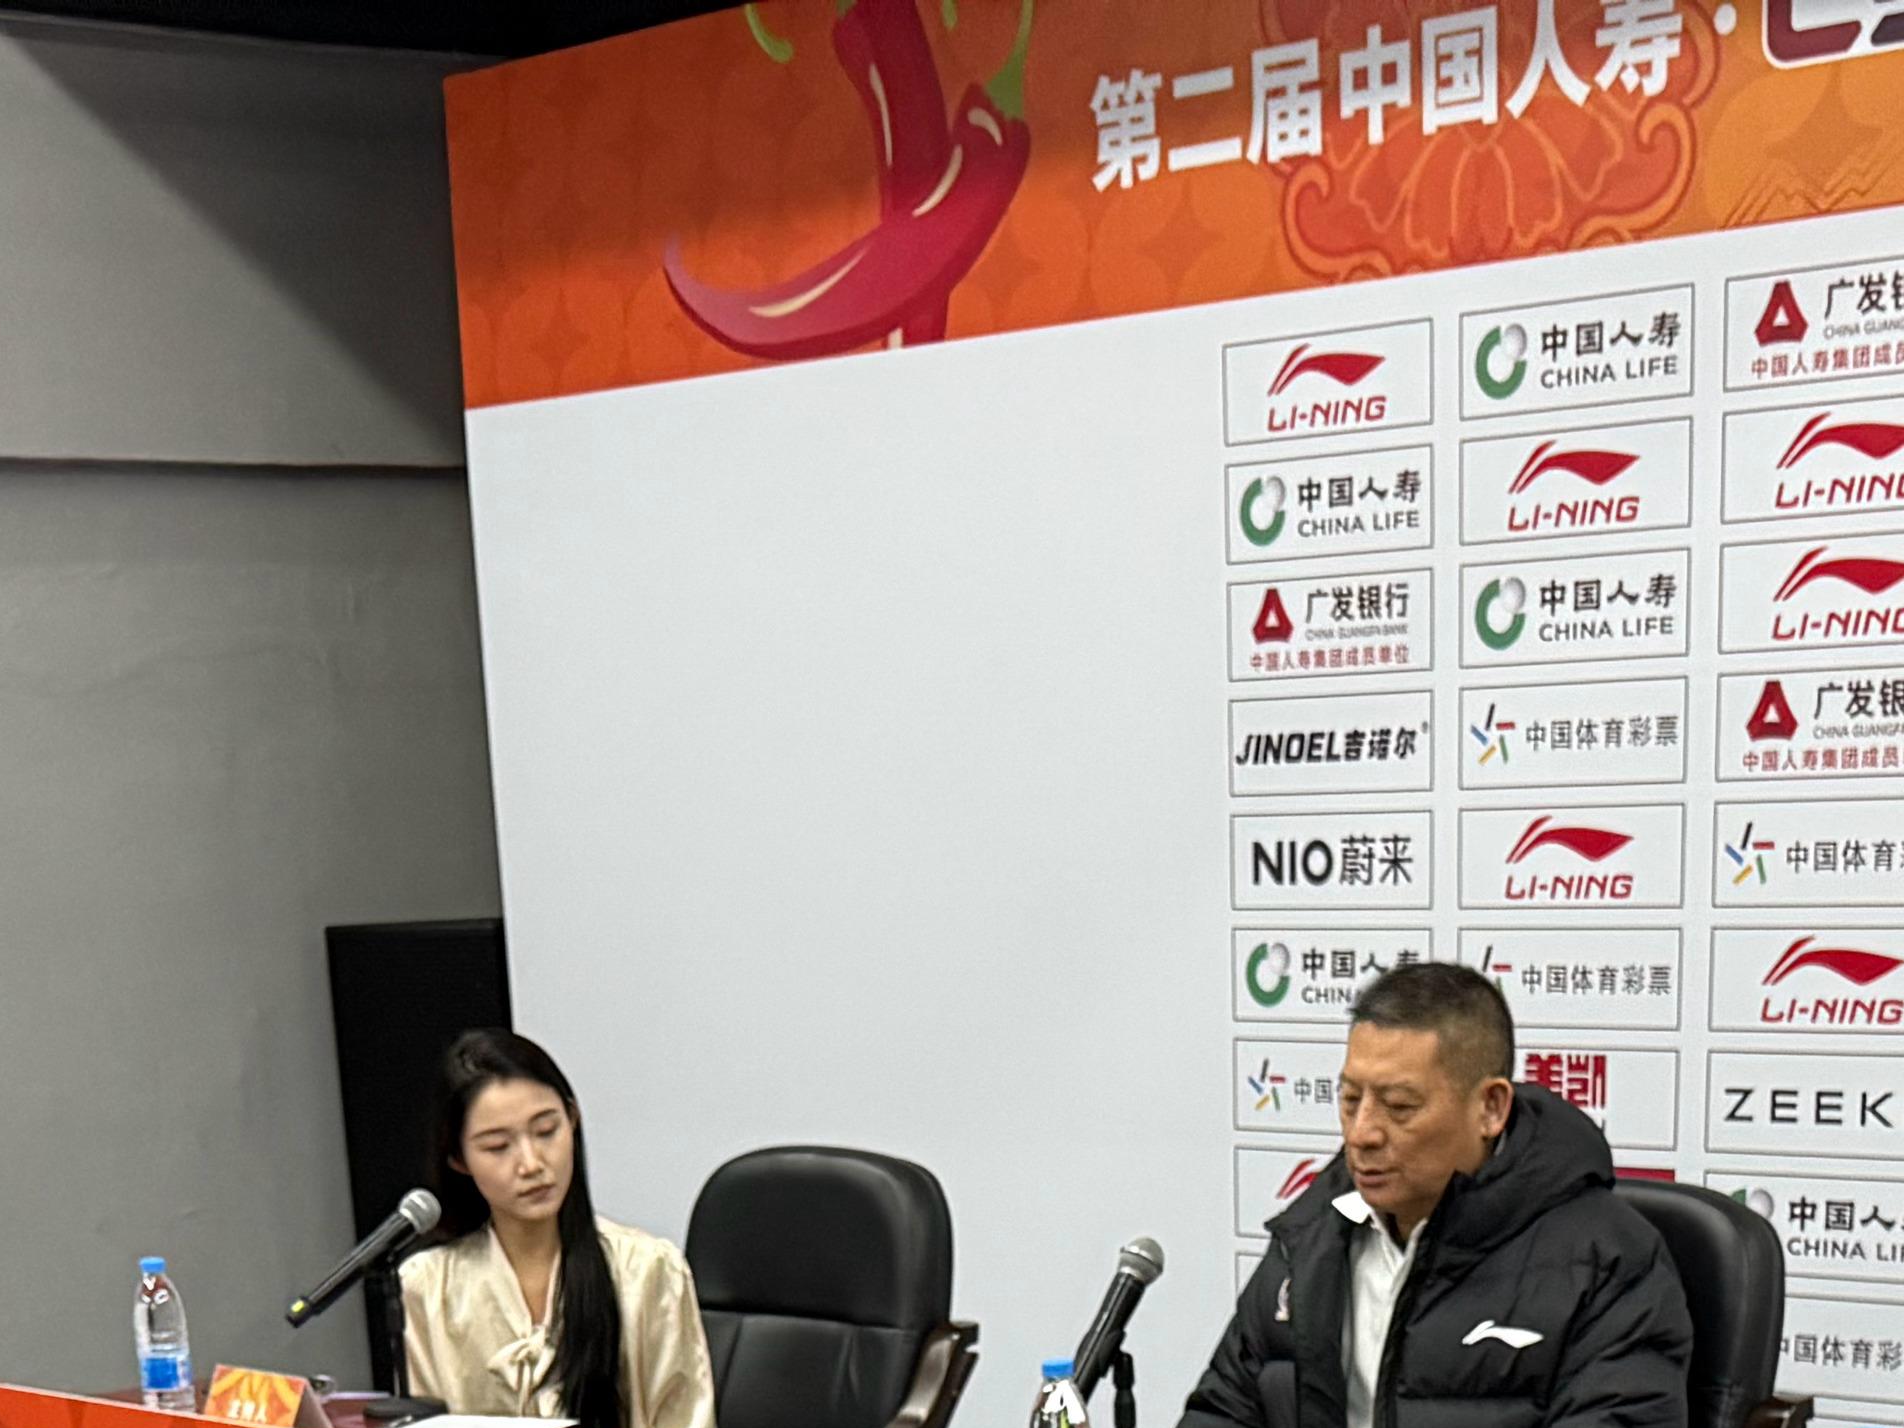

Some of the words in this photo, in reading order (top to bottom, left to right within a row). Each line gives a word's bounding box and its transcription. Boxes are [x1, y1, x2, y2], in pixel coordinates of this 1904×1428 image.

[1542, 312, 1680, 362] 中国人寿
[1541, 364, 1616, 389] CHINA
[1626, 355, 1677, 379] LIFE
[1268, 396, 1386, 432] LI-NING
[1298, 470, 1420, 512] 中国人寿
[1298, 516, 1364, 537] CHINA
[1373, 510, 1419, 531] LIFE
[1508, 496, 1639, 531] LI-NING
[1306, 583, 1408, 622] 广发银行
[1540, 574, 1676, 616] 中国人寿
[1539, 621, 1613, 641] CHINA
[1623, 616, 1673, 637] LIFE
[1526, 716, 1678, 751] 中国体育彩票
[1506, 874, 1633, 899] LI-NING
[1301, 985, 1358, 1004] CHIN
[1522, 965, 1671, 995] 中国体育彩票
[1761, 998, 1904, 1024] LI-NING
[1787, 1238, 1866, 1259] CHINA
